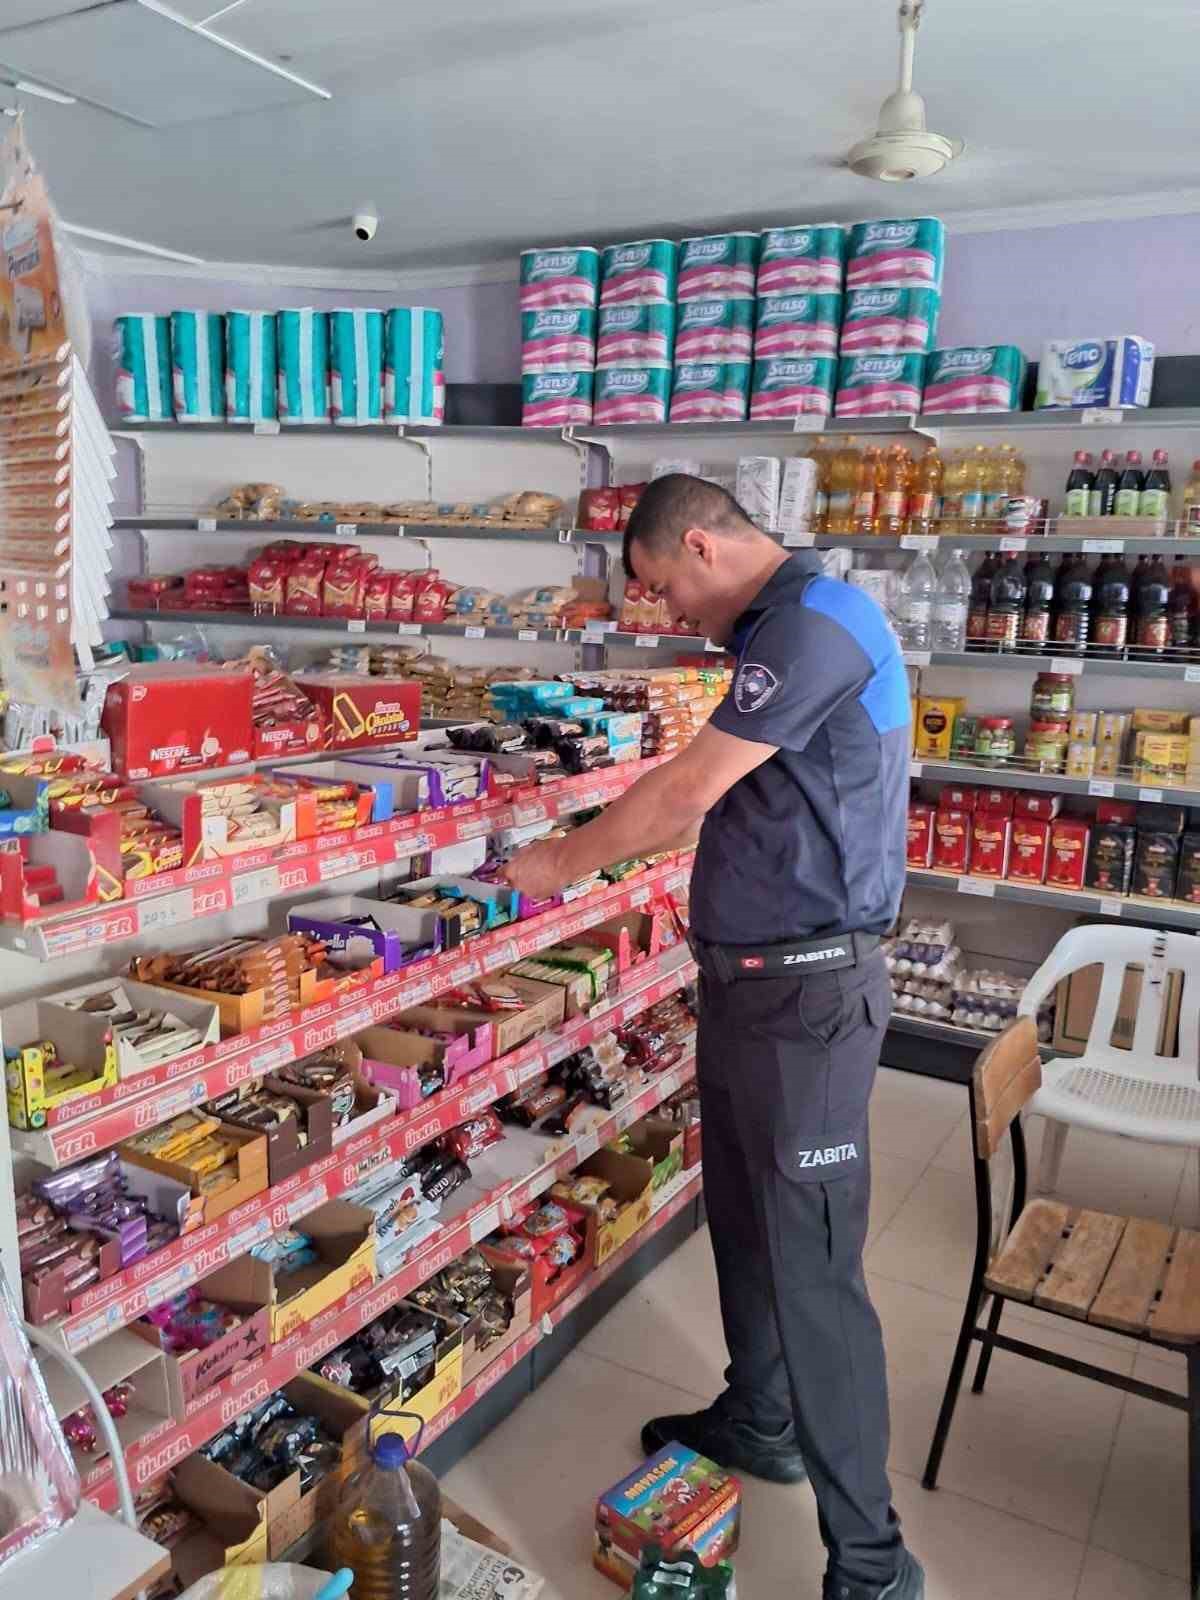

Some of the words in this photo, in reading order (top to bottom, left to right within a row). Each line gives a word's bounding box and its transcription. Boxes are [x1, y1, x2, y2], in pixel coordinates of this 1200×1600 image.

[866, 223, 914, 241] Senso
[687, 240, 726, 255] Senso
[766, 234, 809, 248] Senso
[534, 255, 577, 269] Senso
[684, 303, 724, 317] Senso
[765, 299, 808, 313] Senso
[536, 311, 578, 326] Senso
[854, 357, 903, 371] Senso
[942, 351, 993, 367] Senso
[679, 367, 718, 381] Senso
[768, 361, 814, 376] Senso
[534, 374, 578, 389] Senso
[606, 370, 649, 386] Senso
[783, 947, 846, 965] ZABITA
[405, 1118, 441, 1148] ÜLKER
[798, 1143, 858, 1168] ZABITA
[427, 1177, 450, 1199] nero
[418, 1247, 453, 1279] ÜLKER
[360, 1286, 399, 1319] ÜLKER
[296, 1330, 338, 1369] ÜLKER
[221, 1379, 270, 1423] ÜLKER
[136, 1434, 192, 1484] ÜLKER
